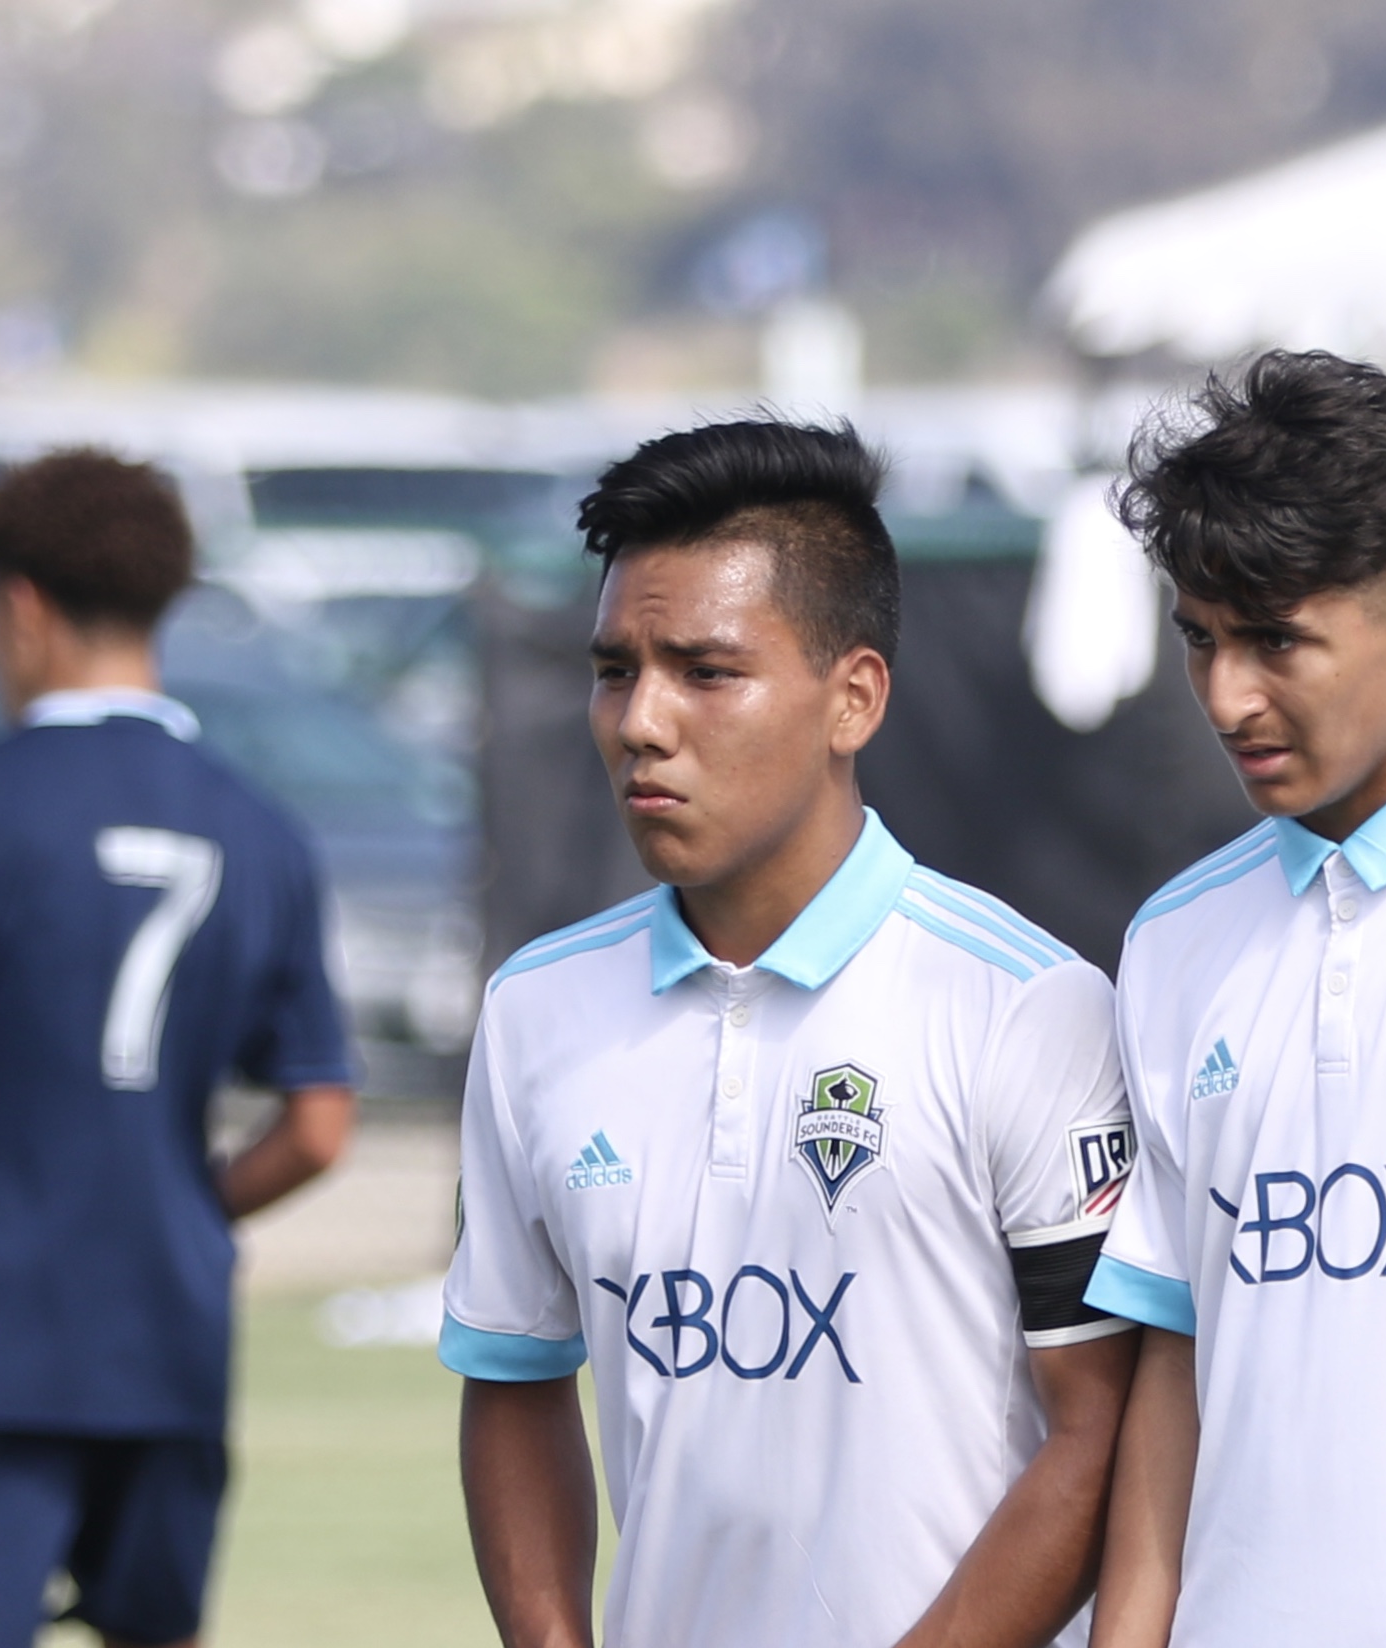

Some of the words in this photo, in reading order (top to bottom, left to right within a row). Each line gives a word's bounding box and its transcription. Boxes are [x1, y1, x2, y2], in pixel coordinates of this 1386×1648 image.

[95, 826, 224, 1091] 7
[1191, 1072, 1239, 1100] adidas
[800, 1121, 860, 1138] SOUNDERS
[863, 1130, 878, 1148] FC
[565, 1167, 632, 1190] adidas
[593, 1264, 863, 1384] XBOX
